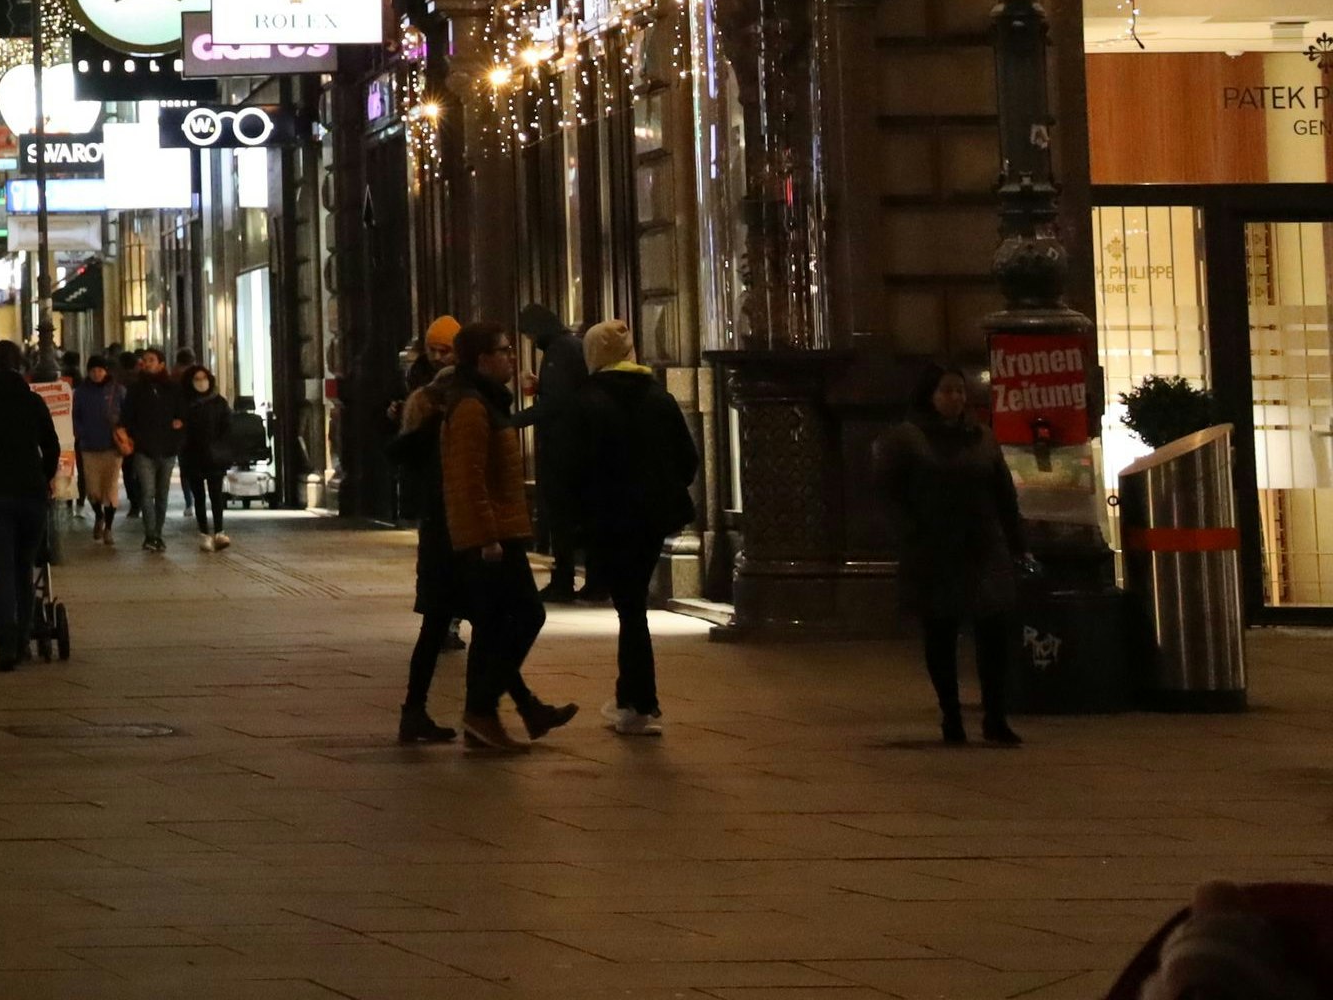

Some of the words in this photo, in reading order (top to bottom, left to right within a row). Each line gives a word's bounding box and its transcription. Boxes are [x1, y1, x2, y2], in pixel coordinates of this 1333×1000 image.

[254, 13, 341, 29] ROLEX
[1223, 86, 1306, 109] PATEK
[1109, 266, 1174, 280] PHILIPPE
[991, 347, 1083, 379] Kronen
[993, 381, 1087, 412] Zeitung
